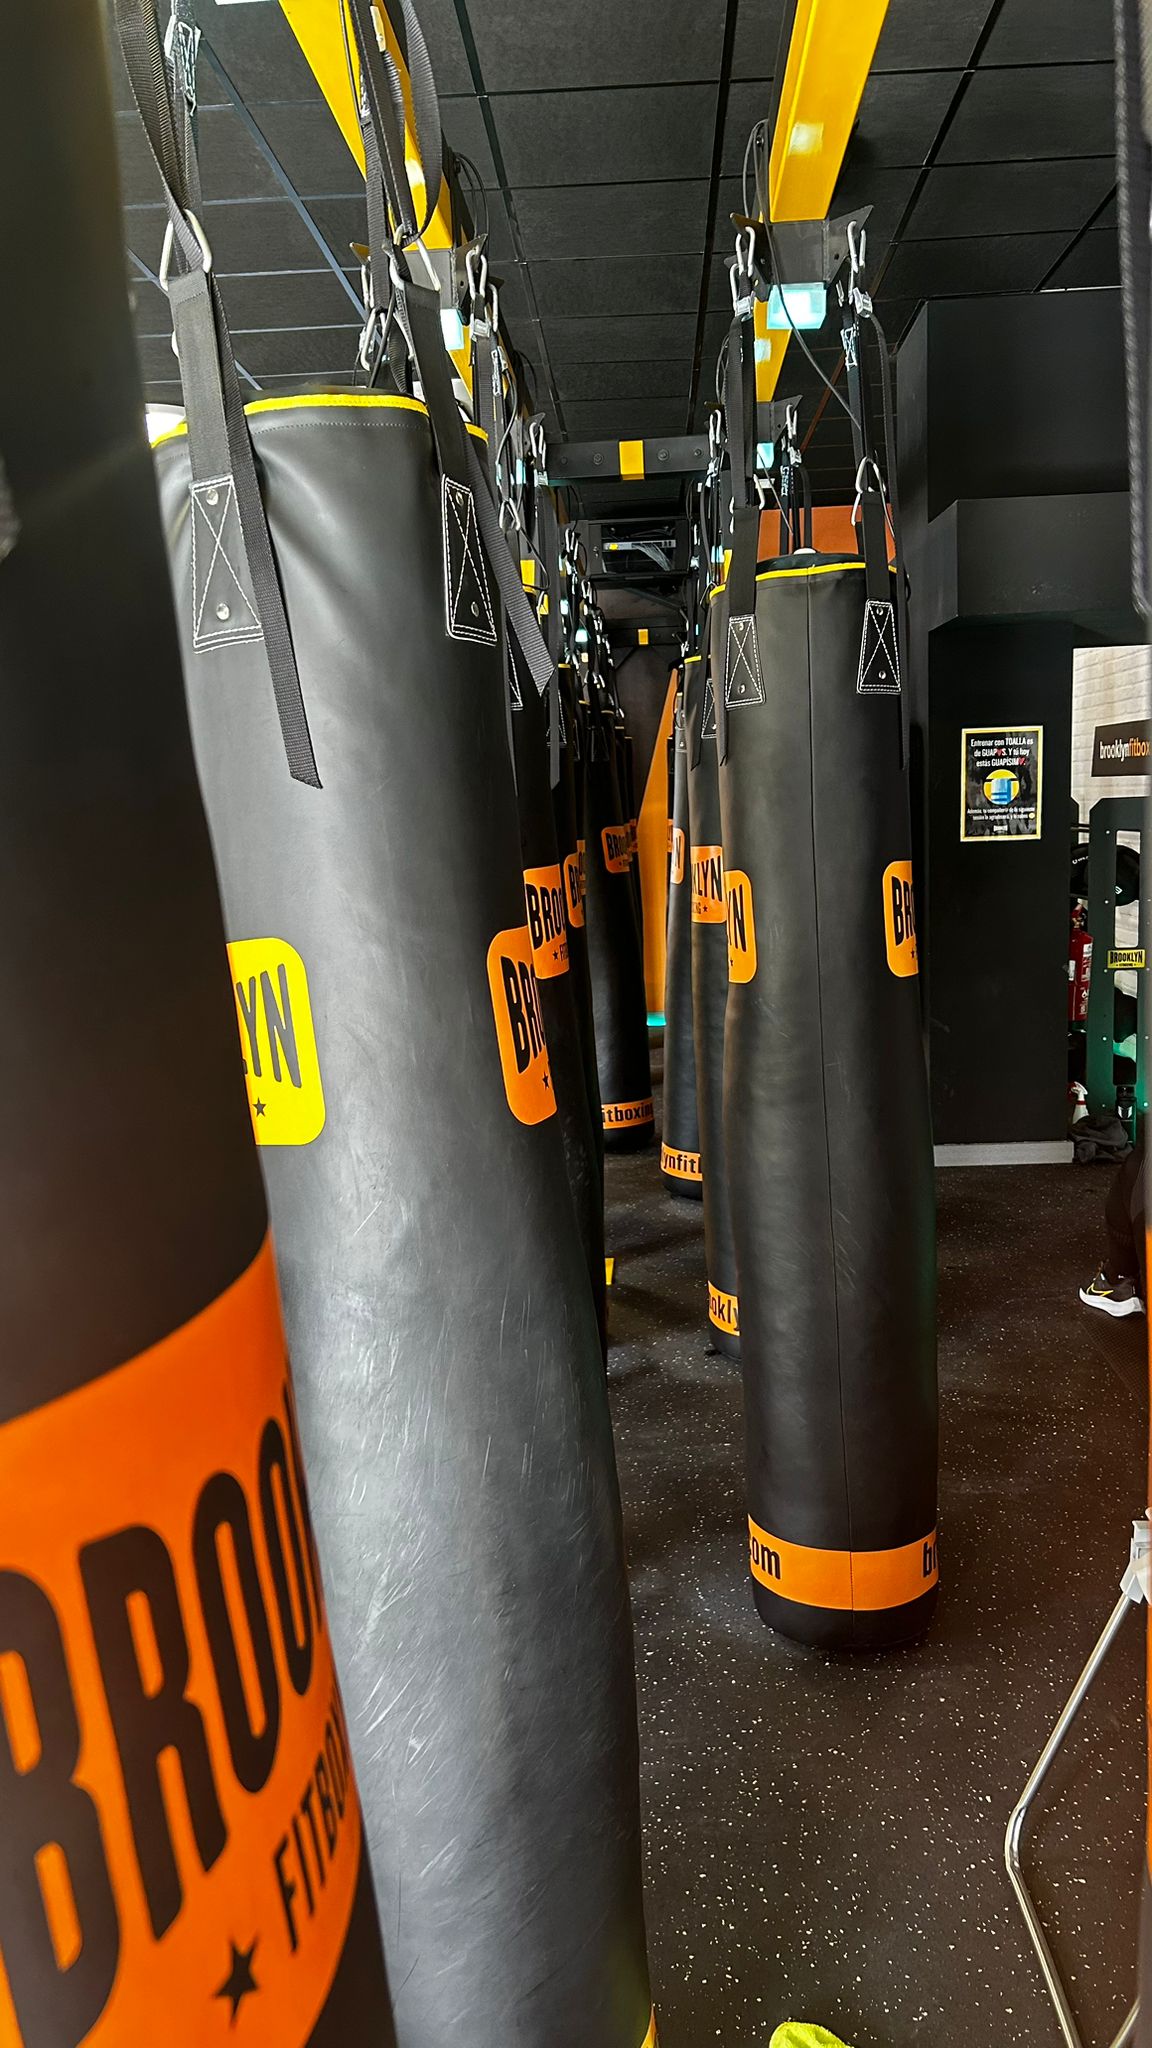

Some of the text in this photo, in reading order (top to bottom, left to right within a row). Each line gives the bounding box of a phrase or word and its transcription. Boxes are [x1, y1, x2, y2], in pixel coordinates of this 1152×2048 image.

[1005, 737, 1026, 745] TOALLA
[973, 749, 981, 757] de
[1008, 748, 1013, 756] Y
[1019, 747, 1030, 756] hoy
[976, 759, 991, 767] estás
[1110, 950, 1143, 964] BROOKLYN
